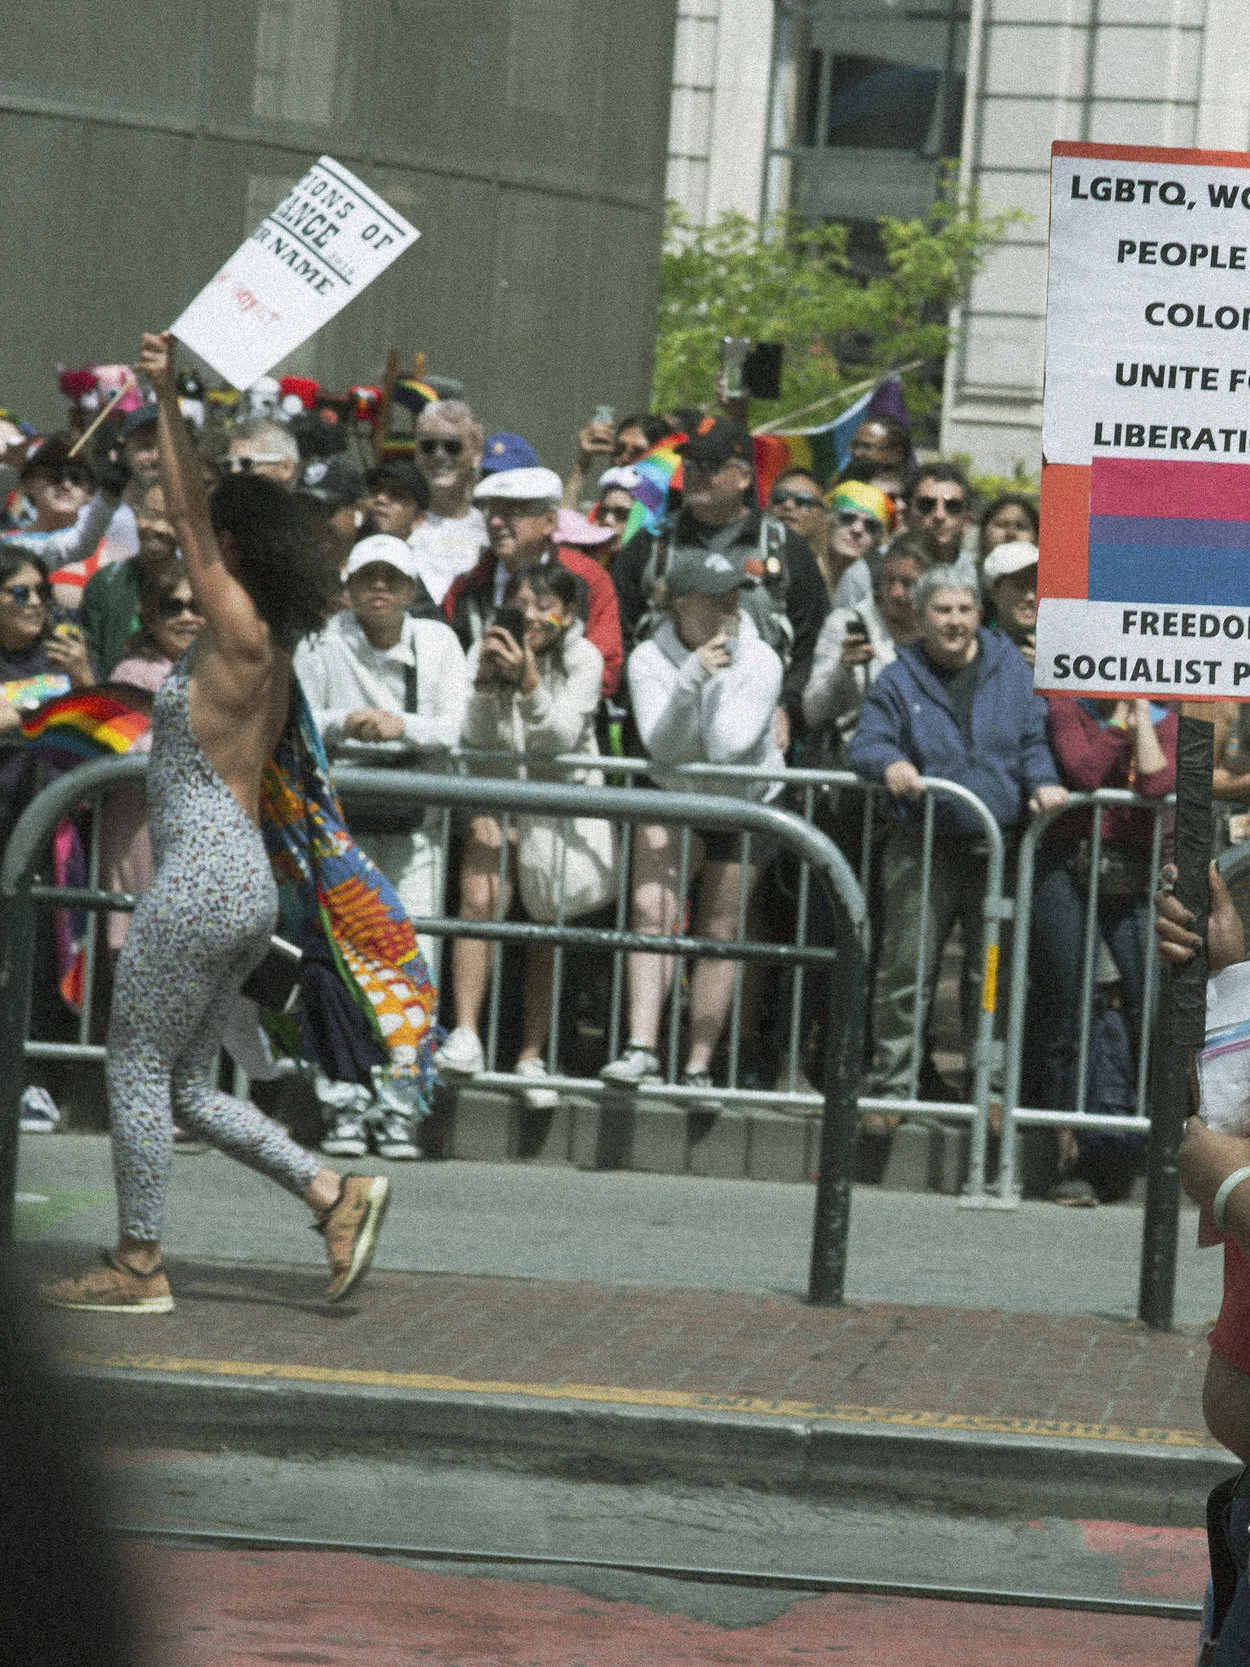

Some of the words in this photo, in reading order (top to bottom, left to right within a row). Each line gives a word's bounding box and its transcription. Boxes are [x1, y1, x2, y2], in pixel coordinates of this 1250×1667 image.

[1070, 176, 1197, 210] LGBTQ,
[267, 237, 335, 295] NAME
[1117, 240, 1247, 270] PEOPLE
[1115, 362, 1219, 391] UNITE
[1053, 654, 1222, 685] SOCIALIST
